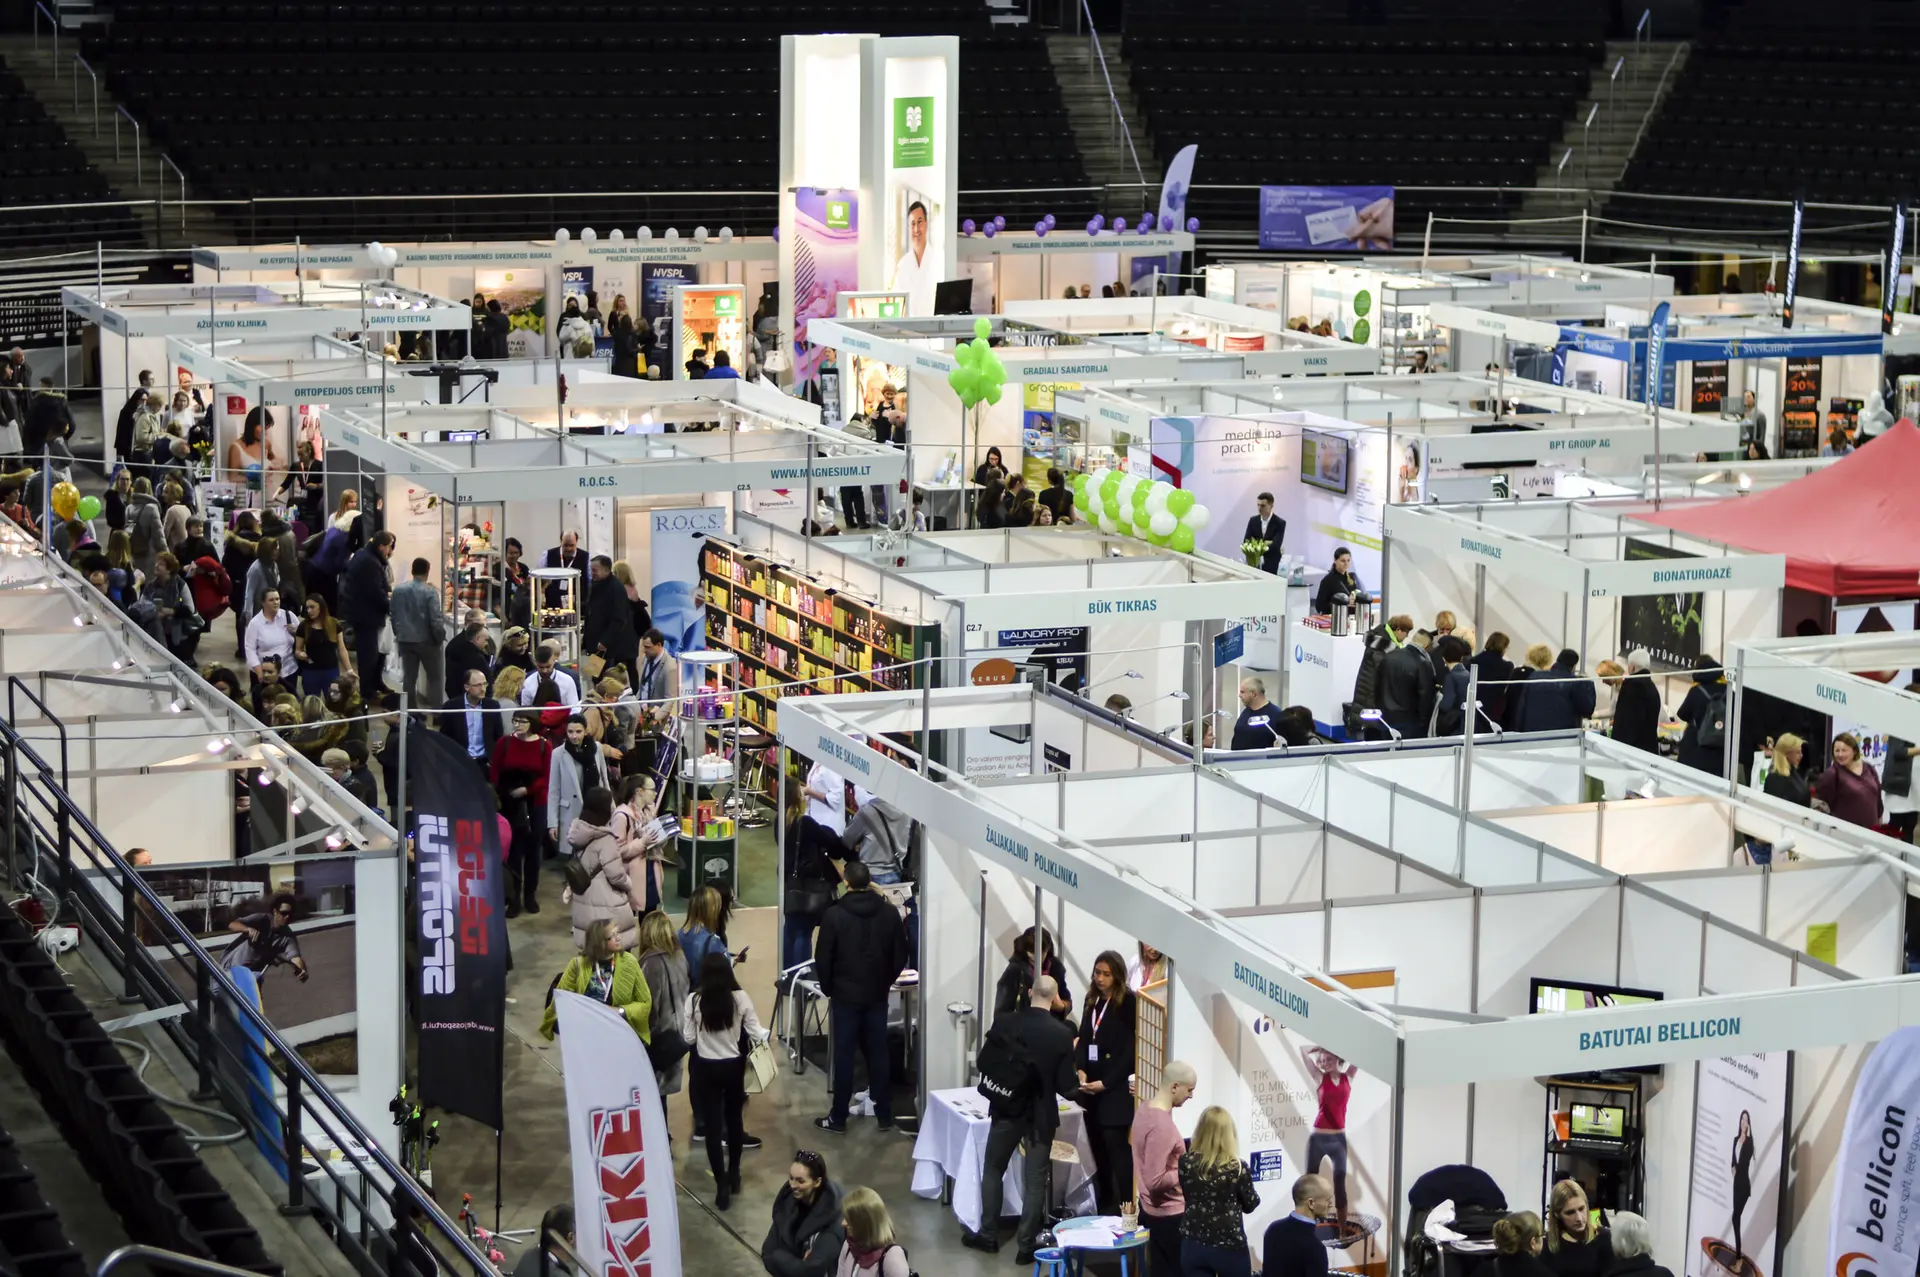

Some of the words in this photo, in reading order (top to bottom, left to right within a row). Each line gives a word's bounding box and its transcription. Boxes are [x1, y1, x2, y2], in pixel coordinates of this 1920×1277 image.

[653, 268, 685, 278] NVSPL
[197, 319, 234, 329] AŽULYNO
[237, 320, 267, 328] KLINIKA
[371, 315, 395, 325] DANTŲ
[397, 315, 431, 324] ESTETIKA
[1303, 357, 1327, 366] VAIKIS
[1023, 366, 1058, 376] GRADIALI
[1060, 364, 1108, 374] SANATORIJA
[295, 386, 353, 397] ORTOPEDIJOS
[1791, 380, 1816, 392] 20%
[1697, 391, 1721, 403] 20%
[1549, 440, 1565, 450] BPT
[1568, 440, 1596, 449] GROUP
[1598, 438, 1610, 448] AG
[579, 475, 618, 488] R.O.C.S.
[1523, 477, 1539, 488] Life
[656, 514, 720, 532] R.O.C.S.
[1653, 566, 1732, 583] BIONATUROAZĖ
[1088, 599, 1112, 614] BŪK
[1116, 598, 1157, 613] TIKRAS
[966, 624, 982, 632] C2.7
[1304, 651, 1312, 662] USP
[1313, 655, 1328, 668] Baltics
[1816, 684, 1847, 705] OLIVETA
[818, 735, 835, 757] JUDĖK
[836, 746, 843, 760] BE
[844, 749, 870, 776] SKAUSMO
[980, 755, 1003, 764] valymo
[966, 763, 997, 772] Guardian
[986, 824, 1028, 862] ŽALIAKALNIO
[1034, 852, 1078, 889] POLIKLINIKA
[1234, 961, 1266, 996] BATUTAI
[1268, 981, 1308, 1019] BELLICON
[1580, 1026, 1651, 1051] BATUTAI
[1658, 1017, 1741, 1042] BELLICON
[1253, 1070, 1268, 1081] TIK
[1253, 1083, 1265, 1094] 10
[1268, 1081, 1291, 1092] MIN.
[1252, 1094, 1273, 1105] PER
[1251, 1107, 1274, 1118] KAD
[1251, 1116, 1309, 1131] IŠLIKTUME
[1251, 1131, 1285, 1144] SVEIKI
[1856, 1105, 1905, 1243] bellicon
[1893, 1205, 1908, 1252] bounce
[1904, 1152, 1917, 1176] feel
